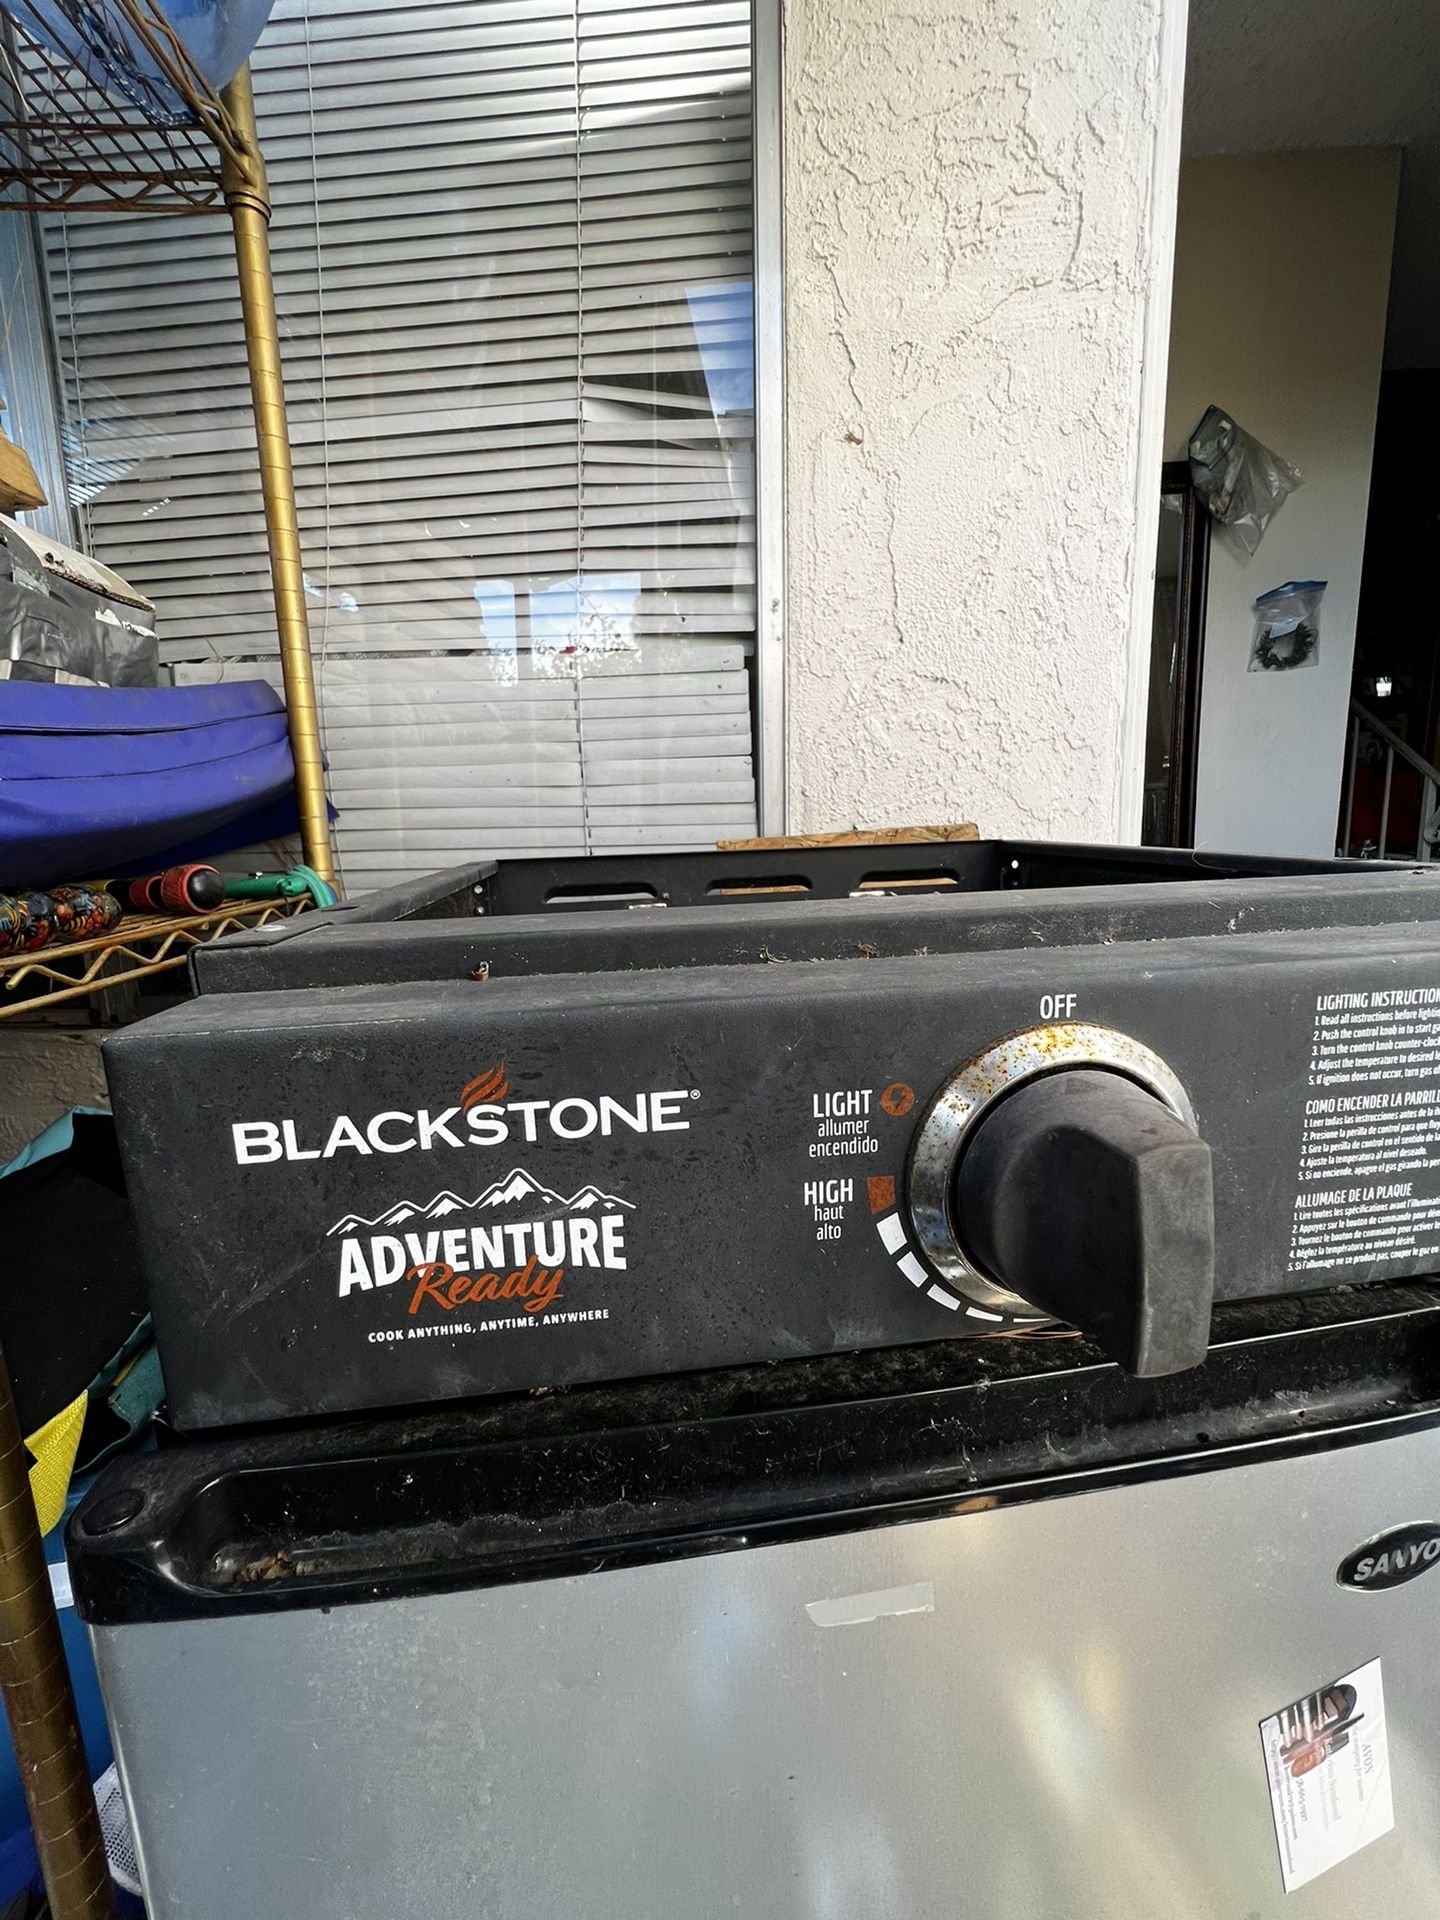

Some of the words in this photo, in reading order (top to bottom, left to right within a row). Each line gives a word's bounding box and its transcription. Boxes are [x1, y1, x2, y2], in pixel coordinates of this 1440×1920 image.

[1040, 994, 1077, 1019] OFF
[1317, 993, 1368, 1011] LIGHTING
[1321, 1014, 1339, 1025] Read
[1340, 1014, 1350, 1024] all
[1351, 1011, 1393, 1023] instructions
[1394, 1009, 1417, 1020] before
[1321, 1029, 1339, 1040] Push
[1340, 1029, 1352, 1039] the
[1353, 1026, 1379, 1038] control
[1380, 1025, 1397, 1036] knob
[1398, 1026, 1406, 1034] in
[1406, 1025, 1414, 1034] to
[1415, 1023, 1432, 1033] start
[1320, 1045, 1335, 1055] Turn
[1337, 1044, 1349, 1054] the
[1350, 1041, 1375, 1053] control
[1376, 1040, 1394, 1050] knob
[1318, 1059, 1341, 1071] Adjust
[1342, 1058, 1354, 1068] the
[1355, 1056, 1398, 1067] temperature
[1399, 1054, 1407, 1063] to
[1408, 1051, 1434, 1063] desired
[1316, 1074, 1322, 1084] If
[1323, 1073, 1350, 1086] ignition
[1351, 1071, 1368, 1081] does
[1369, 1070, 1382, 1080] not
[1382, 1070, 1403, 1079] occur,
[1405, 1068, 1419, 1077] turn
[1419, 1067, 1432, 1078] gas
[814, 1090, 872, 1117] LIGHT
[1306, 1099, 1335, 1115] COMO
[1337, 1094, 1389, 1112] ENCENDER
[1390, 1093, 1402, 1107] LA
[818, 1119, 869, 1137] allumer
[1310, 1119, 1324, 1127] Leer
[1325, 1116, 1343, 1126] todas
[1344, 1115, 1354, 1124] las
[1355, 1112, 1399, 1123] instrucciones
[1399, 1110, 1417, 1119] antes
[1418, 1108, 1426, 1117] de
[1310, 1131, 1338, 1140] Presione
[1346, 1127, 1367, 1139] perilla
[1368, 1126, 1377, 1135] de
[1377, 1123, 1400, 1134] control
[1400, 1124, 1415, 1133] para
[809, 1136, 878, 1157] encendido
[1308, 1145, 1322, 1153] Gire
[1330, 1141, 1351, 1153] perilla
[1352, 1140, 1360, 1149] de
[1361, 1138, 1384, 1148] control
[1385, 1138, 1393, 1146] en
[1394, 1136, 1401, 1145] el
[1401, 1134, 1425, 1144] sentido
[1426, 1133, 1434, 1142] de
[1306, 1157, 1327, 1168] Ajuste
[1336, 1153, 1375, 1164] temperatura
[1376, 1150, 1382, 1160] al
[1383, 1149, 1399, 1158] nivel
[1399, 1146, 1427, 1157] deseado.
[1305, 1171, 1312, 1180] Si
[1322, 1167, 1353, 1178] enciende,
[1354, 1166, 1378, 1176] apague
[1378, 1163, 1385, 1172] el
[1385, 1163, 1397, 1173] gas
[1397, 1159, 1422, 1172] girando
[805, 1179, 853, 1205] HIGH
[1295, 1190, 1347, 1208] ALLUMAGE
[1348, 1188, 1362, 1202] DE
[1363, 1187, 1374, 1201] LA
[1376, 1183, 1413, 1199] PLAQUE
[815, 1206, 844, 1221] haut
[817, 1224, 841, 1240] alto
[338, 1214, 627, 1297] ADVENTURE
[407, 1255, 564, 1315] Ready
[368, 1330, 403, 1342] COOK
[408, 1323, 476, 1338] ANYTHING,
[481, 1317, 538, 1331] ANYTIME,
[543, 1309, 609, 1324] ANYWHERE
[1353, 1538, 1440, 1581] SANYO
[1362, 1743, 1374, 1775] AVON
